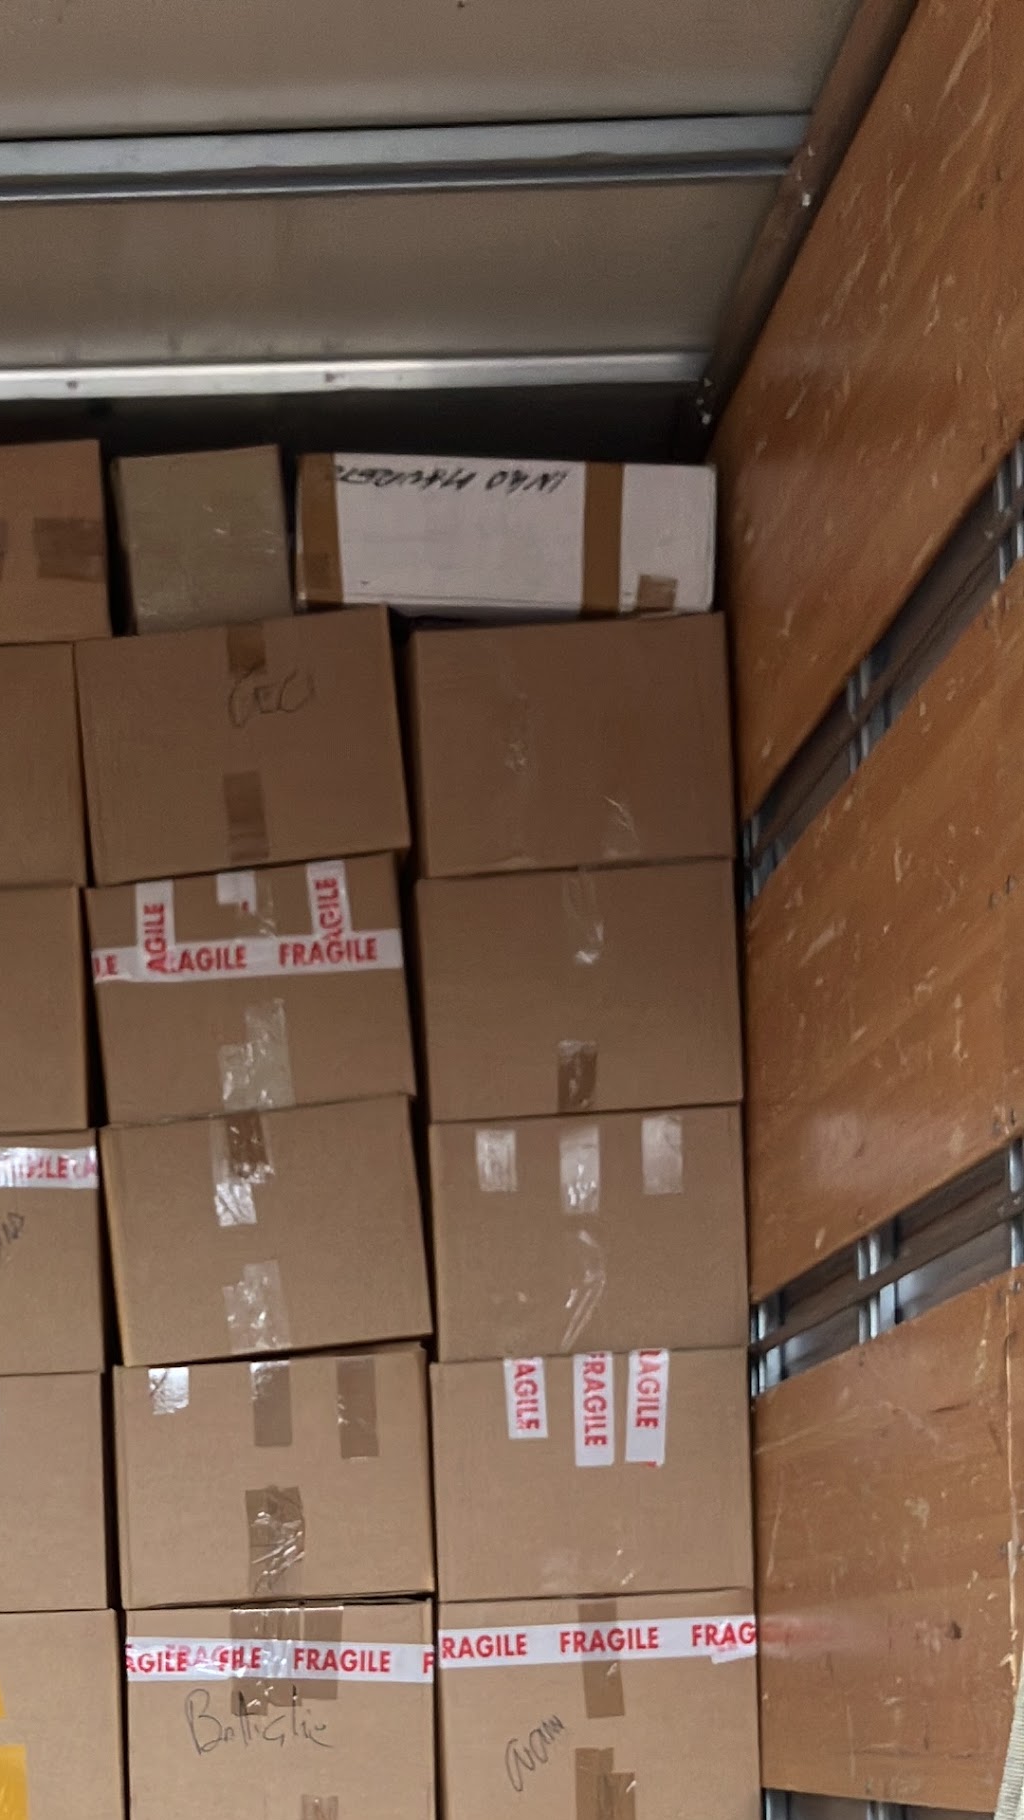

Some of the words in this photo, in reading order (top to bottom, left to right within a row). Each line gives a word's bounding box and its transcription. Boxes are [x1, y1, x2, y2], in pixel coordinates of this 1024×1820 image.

[278, 938, 378, 967] FRAGILE
[582, 1353, 609, 1446] RAGILE
[559, 1627, 659, 1653] FRAGILE
[293, 1648, 391, 1673] FRAGILE
